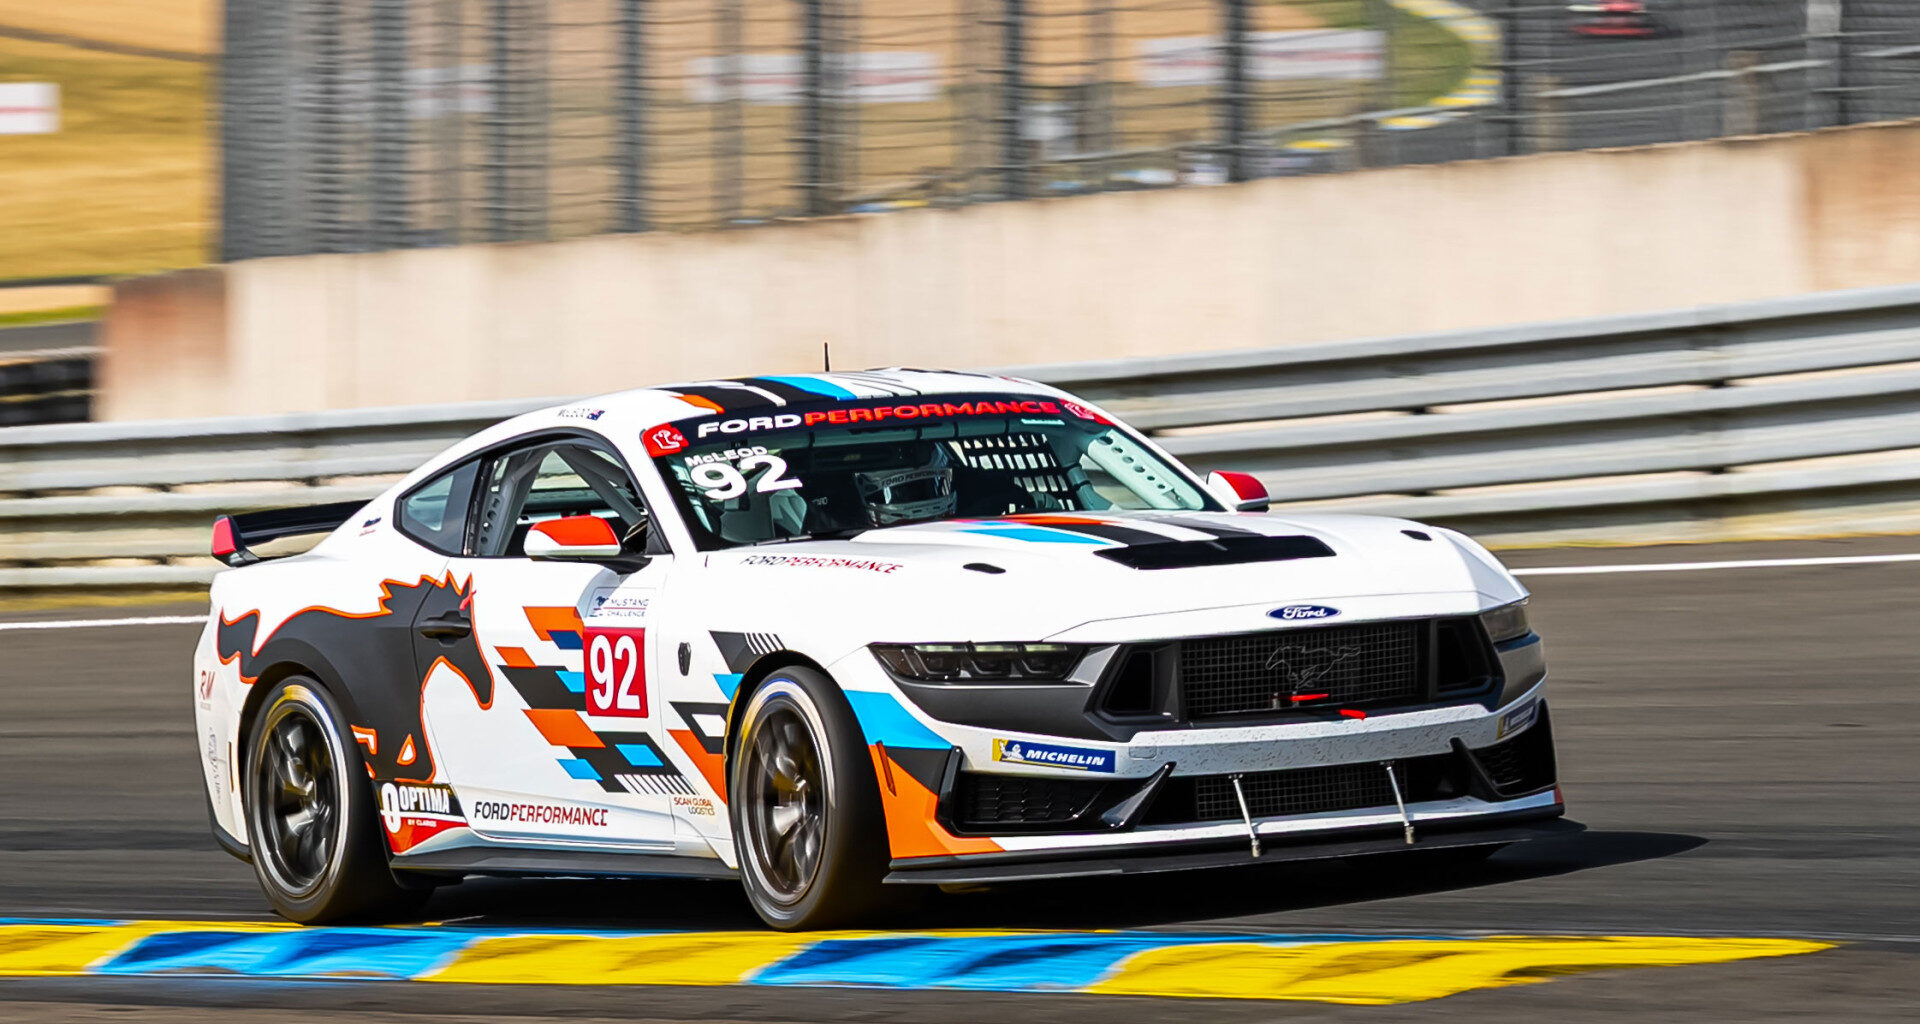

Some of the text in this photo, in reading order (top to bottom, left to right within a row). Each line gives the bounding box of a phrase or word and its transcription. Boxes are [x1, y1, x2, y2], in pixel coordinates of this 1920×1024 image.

[684, 446, 768, 467] McLEOD
[690, 454, 803, 500] 92
[1282, 606, 1327, 620] Ford
[589, 634, 641, 710] 92
[1026, 749, 1106, 766] MICHELIN
[398, 785, 450, 814] OPTIMA
